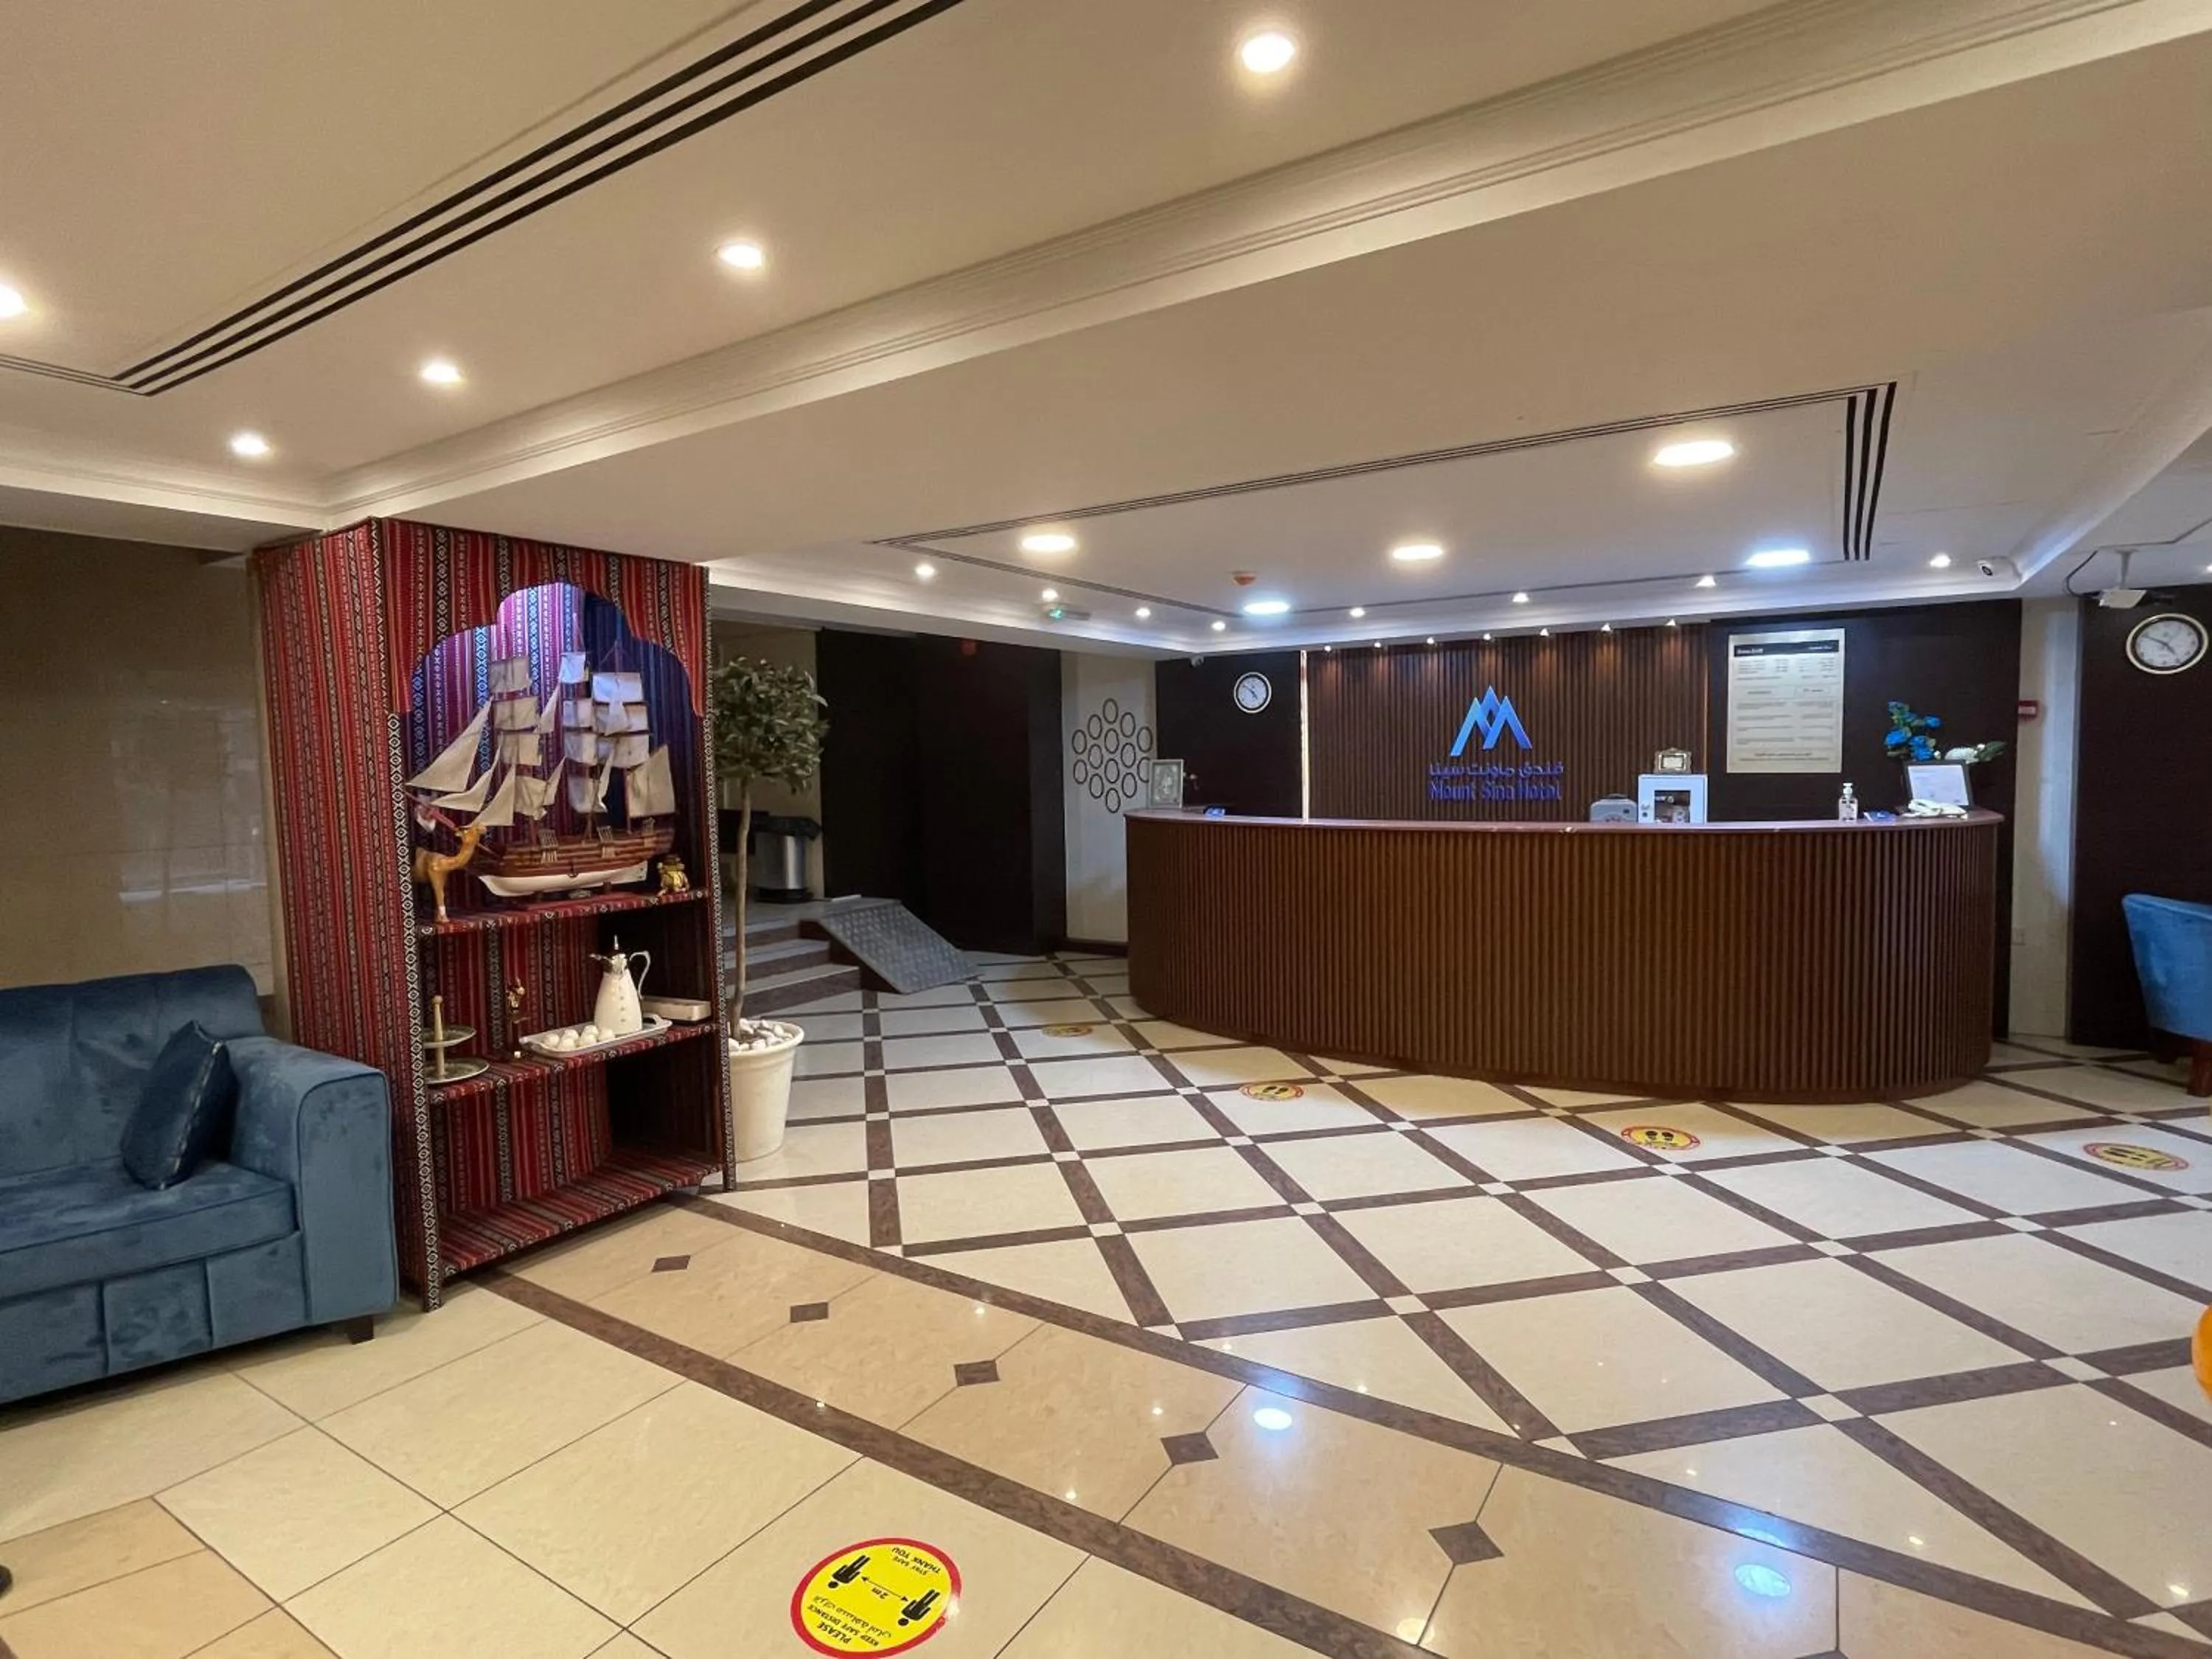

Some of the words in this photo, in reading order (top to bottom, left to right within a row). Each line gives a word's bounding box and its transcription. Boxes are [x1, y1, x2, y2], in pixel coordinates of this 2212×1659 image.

[1430, 779, 1476, 801] Mount
[891, 1547, 911, 1559] YOU
[913, 1557, 941, 1574] THANK
[807, 1604, 841, 1625] DISTANCE
[817, 1622, 852, 1644] PLEASE
[841, 1624, 860, 1636] SAFE
[860, 1634, 880, 1646] KEEP
